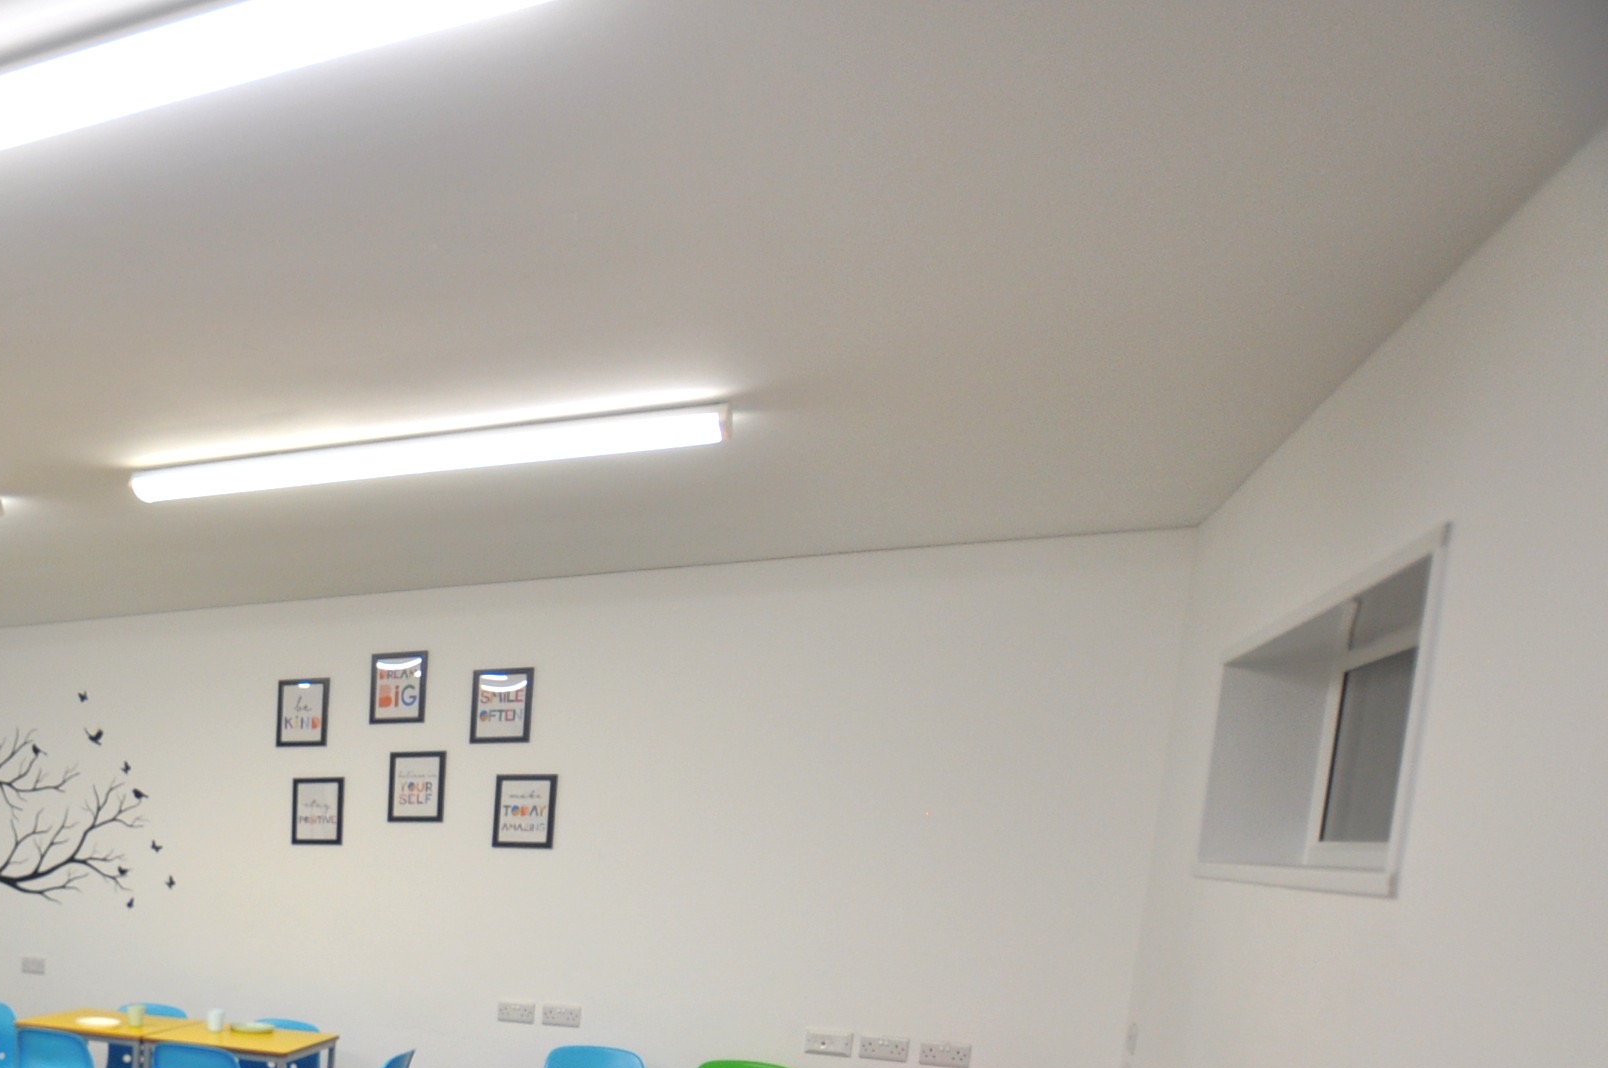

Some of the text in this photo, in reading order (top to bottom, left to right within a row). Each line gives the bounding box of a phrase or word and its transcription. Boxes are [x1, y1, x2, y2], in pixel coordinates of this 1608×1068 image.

[480, 689, 524, 704] SMILE
[294, 695, 312, 712] be
[479, 708, 524, 722] OFTEN
[401, 780, 433, 793] YOUR
[399, 793, 433, 806] SELF
[502, 804, 547, 817] TODAY
